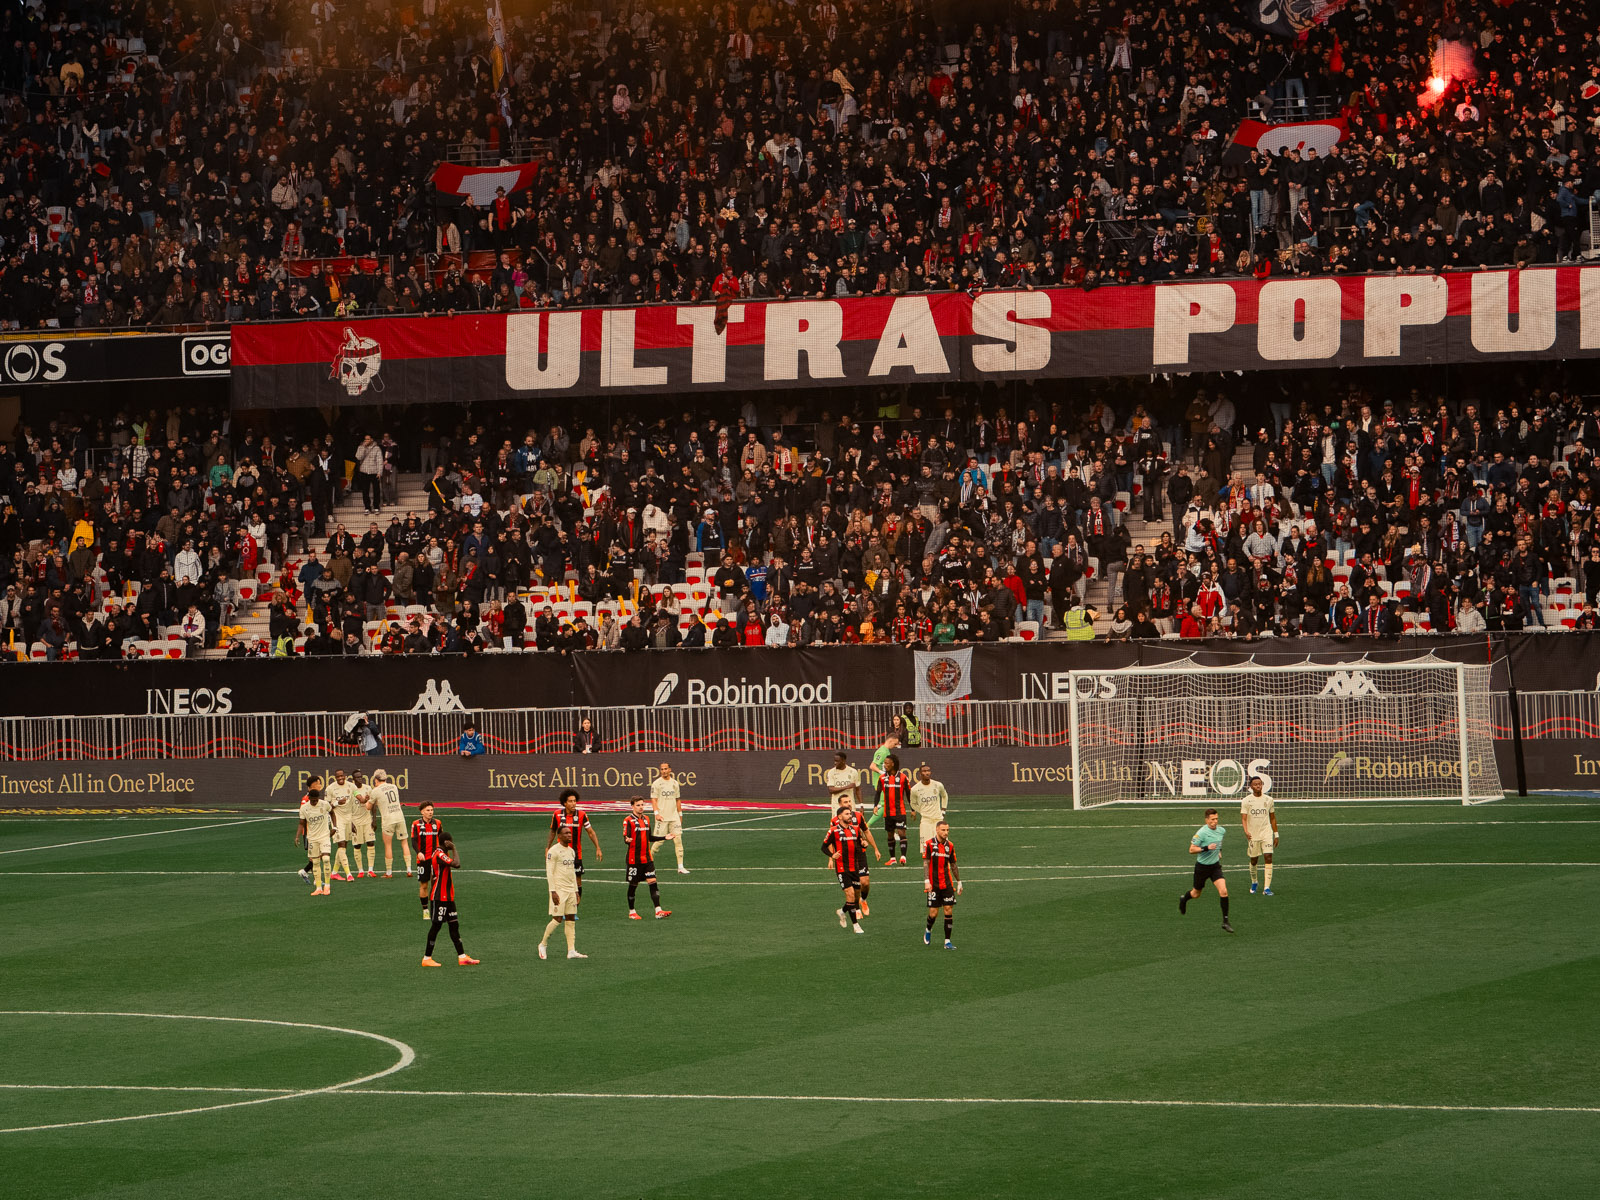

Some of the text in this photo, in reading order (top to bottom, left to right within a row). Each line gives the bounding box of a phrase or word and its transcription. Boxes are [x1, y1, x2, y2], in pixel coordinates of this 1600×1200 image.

[505, 291, 1052, 391] ULTRAS
[0, 343, 67, 383] OS
[190, 343, 231, 365] OG
[688, 675, 832, 705] Robinhood
[1021, 672, 1117, 700] INEOS
[146, 687, 232, 715] INEOS
[1, 772, 195, 794] Invest All in One Place
[488, 769, 546, 789] Invest
[548, 767, 578, 788] All
[581, 767, 600, 787] in
[604, 766, 643, 787] One
[1011, 762, 1073, 783] Invest
[1079, 760, 1107, 782] All
[1113, 760, 1132, 781] in
[1144, 759, 1272, 796] NEOS
[385, 790, 398, 804] 10
[1250, 808, 1268, 817] apm
[628, 867, 638, 876] 23
[438, 906, 448, 916] 37
